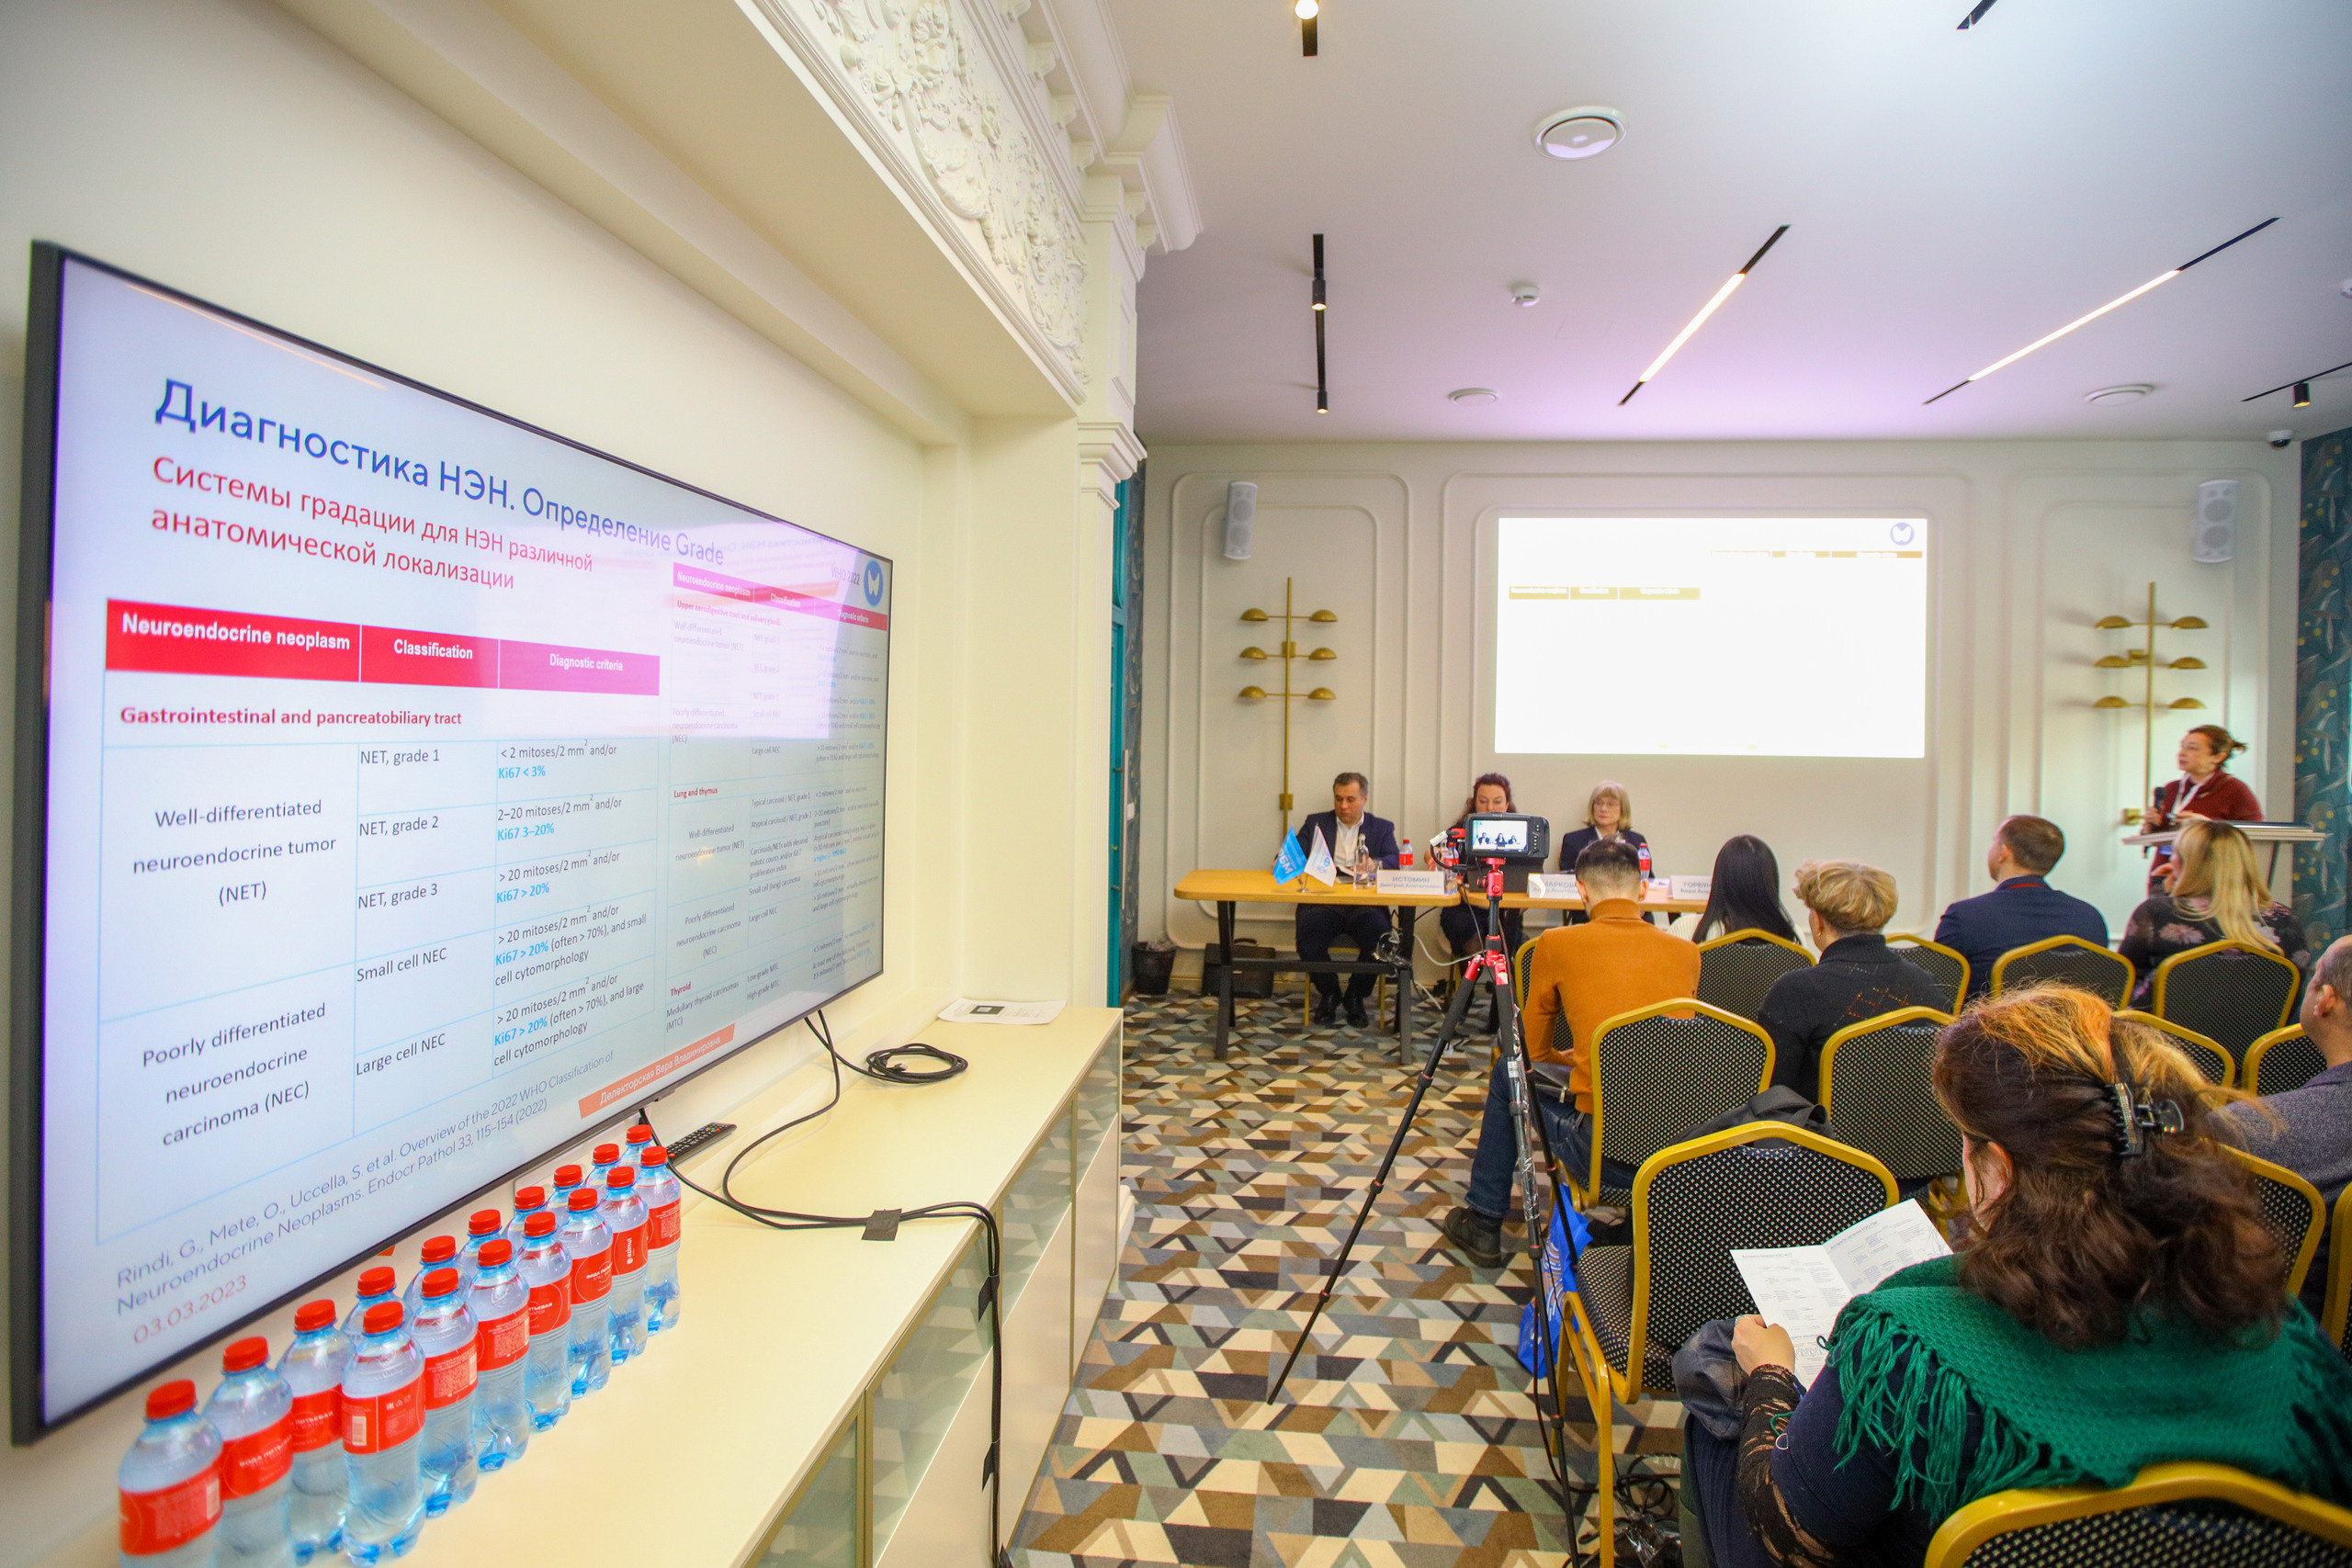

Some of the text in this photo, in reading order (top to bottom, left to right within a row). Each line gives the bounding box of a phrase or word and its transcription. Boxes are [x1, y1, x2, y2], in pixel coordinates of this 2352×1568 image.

[155, 378, 428, 487] Диагностика
[439, 460, 514, 510] НЭН.
[523, 487, 672, 551] Определение
[675, 533, 724, 566] Grade
[153, 457, 593, 572] Системы градации для НЭН различной
[152, 508, 514, 590] анатомической локализации
[677, 570, 751, 597] Neuroendocrine neoplasm
[831, 565, 861, 585] WHO 2022
[121, 613, 350, 651] Neuroendocrine neoplasm
[393, 638, 473, 660] Classification
[549, 653, 623, 671] Diagnostic criteria
[120, 706, 462, 728] Gastrointestinal and pancreatobiliary tract
[360, 749, 440, 766] NET, grade 1
[510, 743, 617, 759] 2 mitoses/2 and/or
[498, 765, 546, 780] Ki67 3%
[673, 786, 718, 799] Lung and thymus
[154, 799, 322, 828] Well-differentiated
[526, 802, 571, 818] mitoses/2
[594, 796, 622, 810] and/or
[359, 816, 439, 837] NET, grade 2
[497, 828, 520, 841] Ki67
[688, 824, 735, 839] Well-differentiated
[133, 839, 336, 874] neuroendocrine tumor
[675, 840, 745, 861] neuroendocrine tumor (NET)
[508, 851, 620, 882] 20 mitoses/2 and/or
[219, 880, 267, 907] (NET)
[357, 883, 438, 909] NET, grade 3
[496, 882, 550, 904] Ki67 20%
[749, 886, 761, 896] Small
[761, 883, 769, 892] cell
[507, 905, 619, 943] 20 mitoses/2 and/or
[684, 902, 735, 925] Poorly differentiated
[748, 906, 778, 922] Large cell NEC
[495, 914, 647, 965] Ki67 20% (often 70%), and small
[676, 920, 741, 947] neuroendocrine carcinoma
[356, 947, 447, 982] Small cell NEC
[702, 945, 718, 959] (NEC)
[495, 950, 589, 987] cell cytomorphology
[506, 974, 618, 1022] 20 mitoses/2 and/or
[666, 981, 739, 1018] Medullary thyroid carcinomas
[670, 981, 692, 997] Thyroid
[494, 982, 644, 1046] Ki67 20% (often 70%), and large
[666, 1016, 684, 1032] (MTC)
[142, 1002, 326, 1068] Poorly differentiated
[493, 1021, 588, 1066] cell cytomorphology
[356, 1032, 447, 1076] Large cell NEC
[165, 1048, 308, 1104] neuroendocrine
[599, 1036, 720, 1106] Делекторская Вера Владимировна
[163, 1080, 310, 1146] carcinoma (NEC)
[118, 1050, 614, 1290] Rindi, G., Mete, O., Uccella, S. et al. Overview of the 2022 WHO Classification of
[118, 1098, 548, 1316] Neuroendocrine Neoplasms. Endocr Pathol 33, (2022)
[133, 1274, 247, 1344] 03.03.2023
